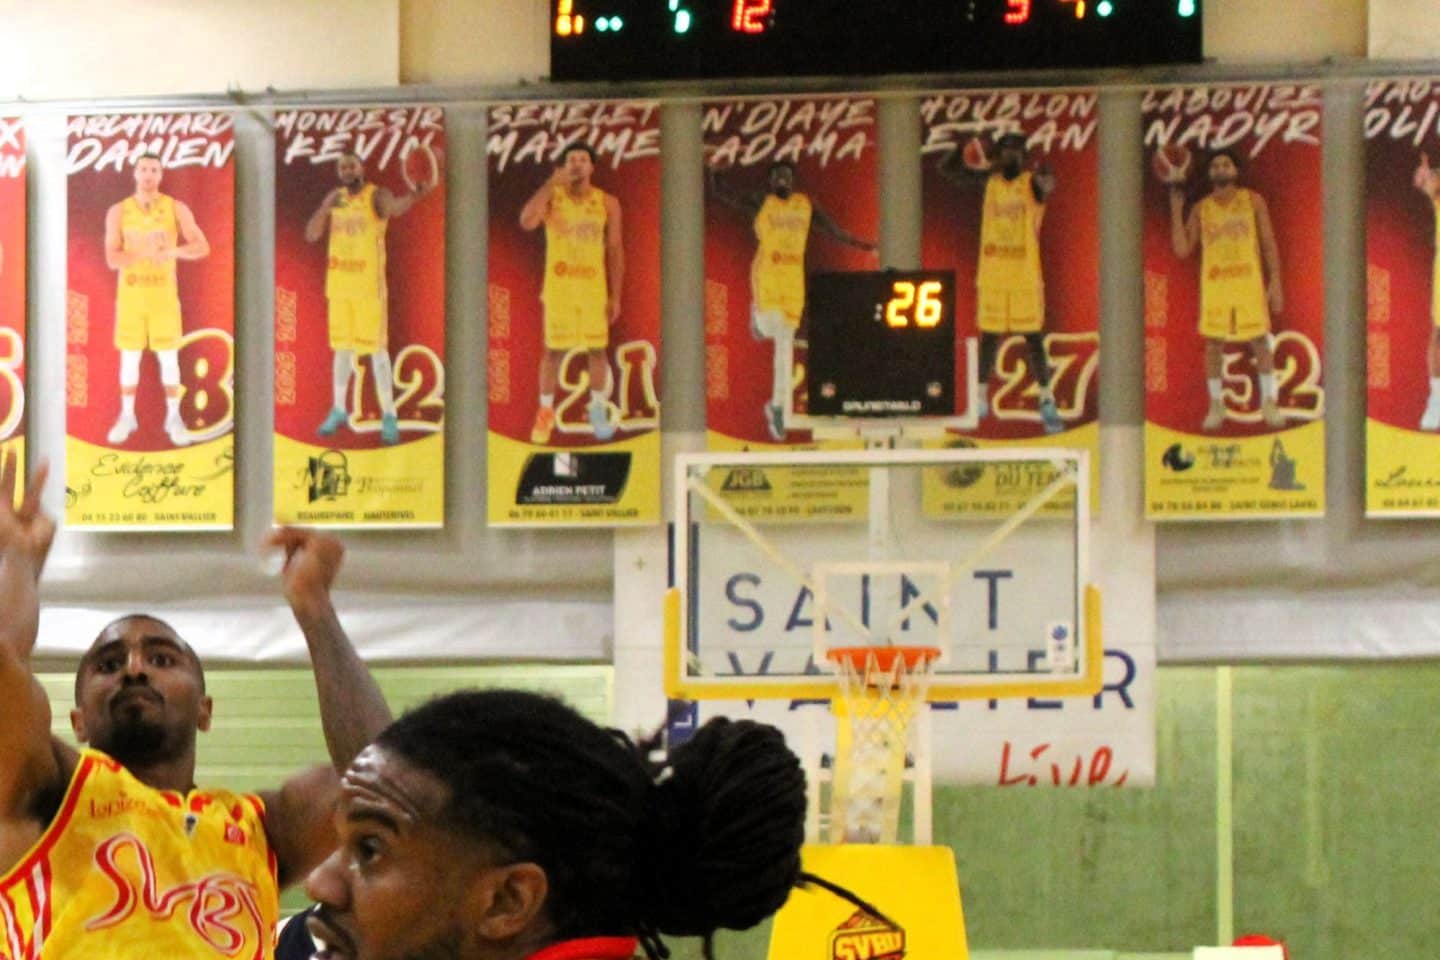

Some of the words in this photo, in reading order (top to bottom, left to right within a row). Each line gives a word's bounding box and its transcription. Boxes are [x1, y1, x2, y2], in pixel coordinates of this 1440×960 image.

[275, 107, 444, 138] MONDESIR
[703, 99, 875, 131] N'DIAYE
[921, 90, 1097, 123] HOUBLON
[66, 134, 235, 175] DAMIEN
[284, 134, 436, 170] KEVIN
[486, 127, 660, 172] MAXIME
[711, 132, 868, 166] ADAMA
[1144, 109, 1321, 158] NADYR
[348, 344, 445, 432] 12
[555, 340, 661, 432] 21
[991, 332, 1101, 419] 27
[1219, 330, 1325, 423] 52
[575, 485, 606, 496] PETIT
[724, 570, 1014, 632] SAINT
